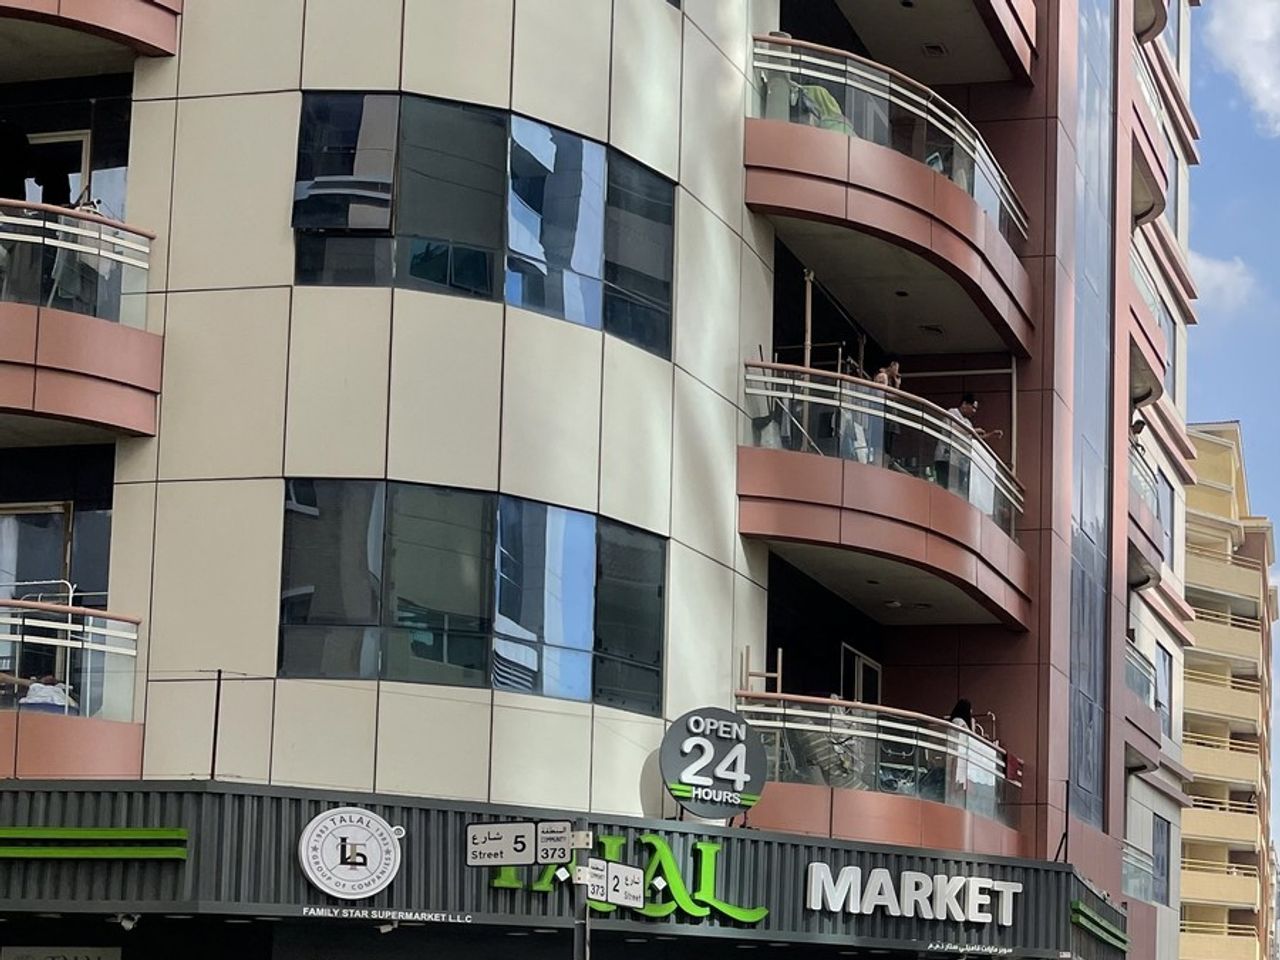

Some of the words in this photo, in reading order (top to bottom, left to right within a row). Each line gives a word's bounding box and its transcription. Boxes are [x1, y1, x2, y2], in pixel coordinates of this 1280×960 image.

[687, 715, 747, 741] OPEN
[681, 736, 751, 791] 24
[691, 786, 741, 805] HOURS
[329, 814, 372, 829] TALAL
[471, 830, 503, 846] شارع
[512, 834, 527, 853] 5
[471, 850, 504, 860] Street
[541, 847, 566, 860] 373
[311, 854, 333, 881] GROUP
[351, 857, 391, 890] COMPANIES
[493, 833, 769, 923] LAL
[806, 861, 1023, 927] MARKET
[590, 883, 605, 898] 373
[612, 874, 620, 893] 2
[302, 906, 340, 917] FAMILY
[342, 909, 368, 919] STAR
[371, 910, 447, 922] SUPERMARKET
